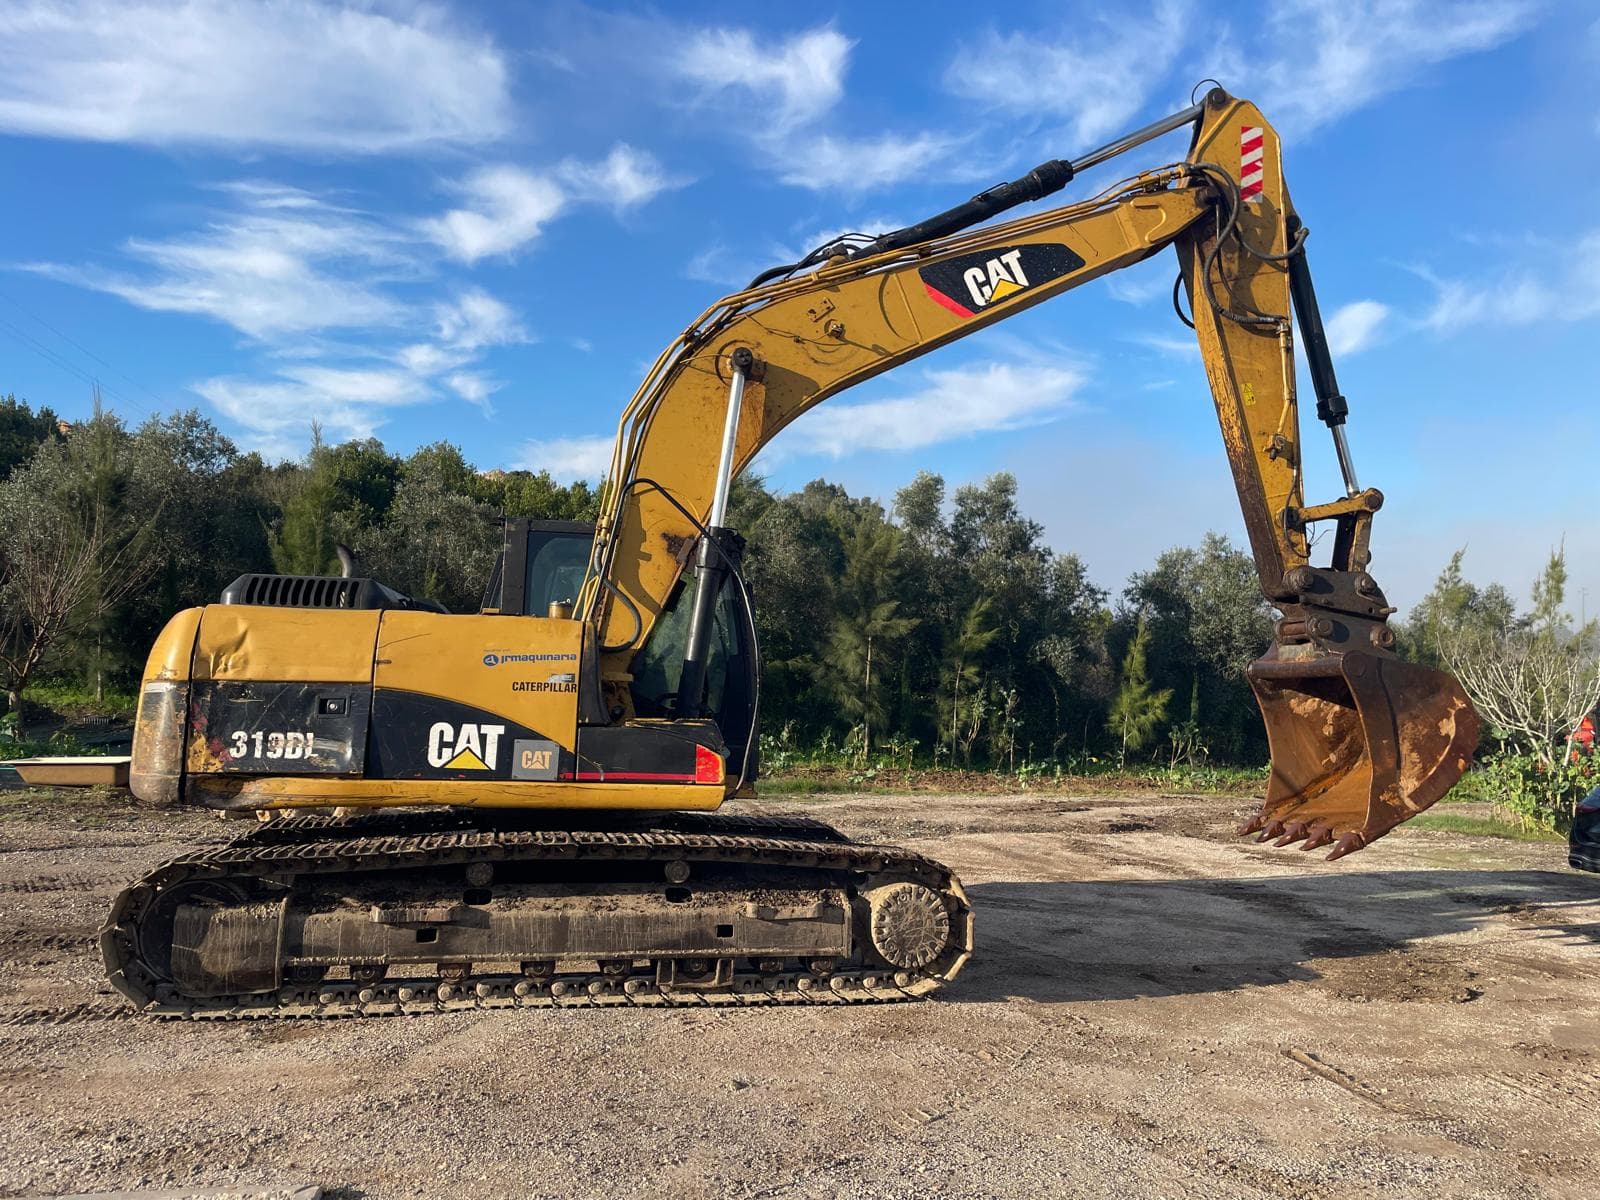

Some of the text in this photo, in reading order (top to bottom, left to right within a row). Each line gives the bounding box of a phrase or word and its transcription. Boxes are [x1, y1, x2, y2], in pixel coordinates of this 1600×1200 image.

[963, 249, 1029, 306] CAT
[512, 681, 577, 693] CATERPILLAR
[427, 722, 505, 770] CAT
[521, 750, 553, 770] CAT
